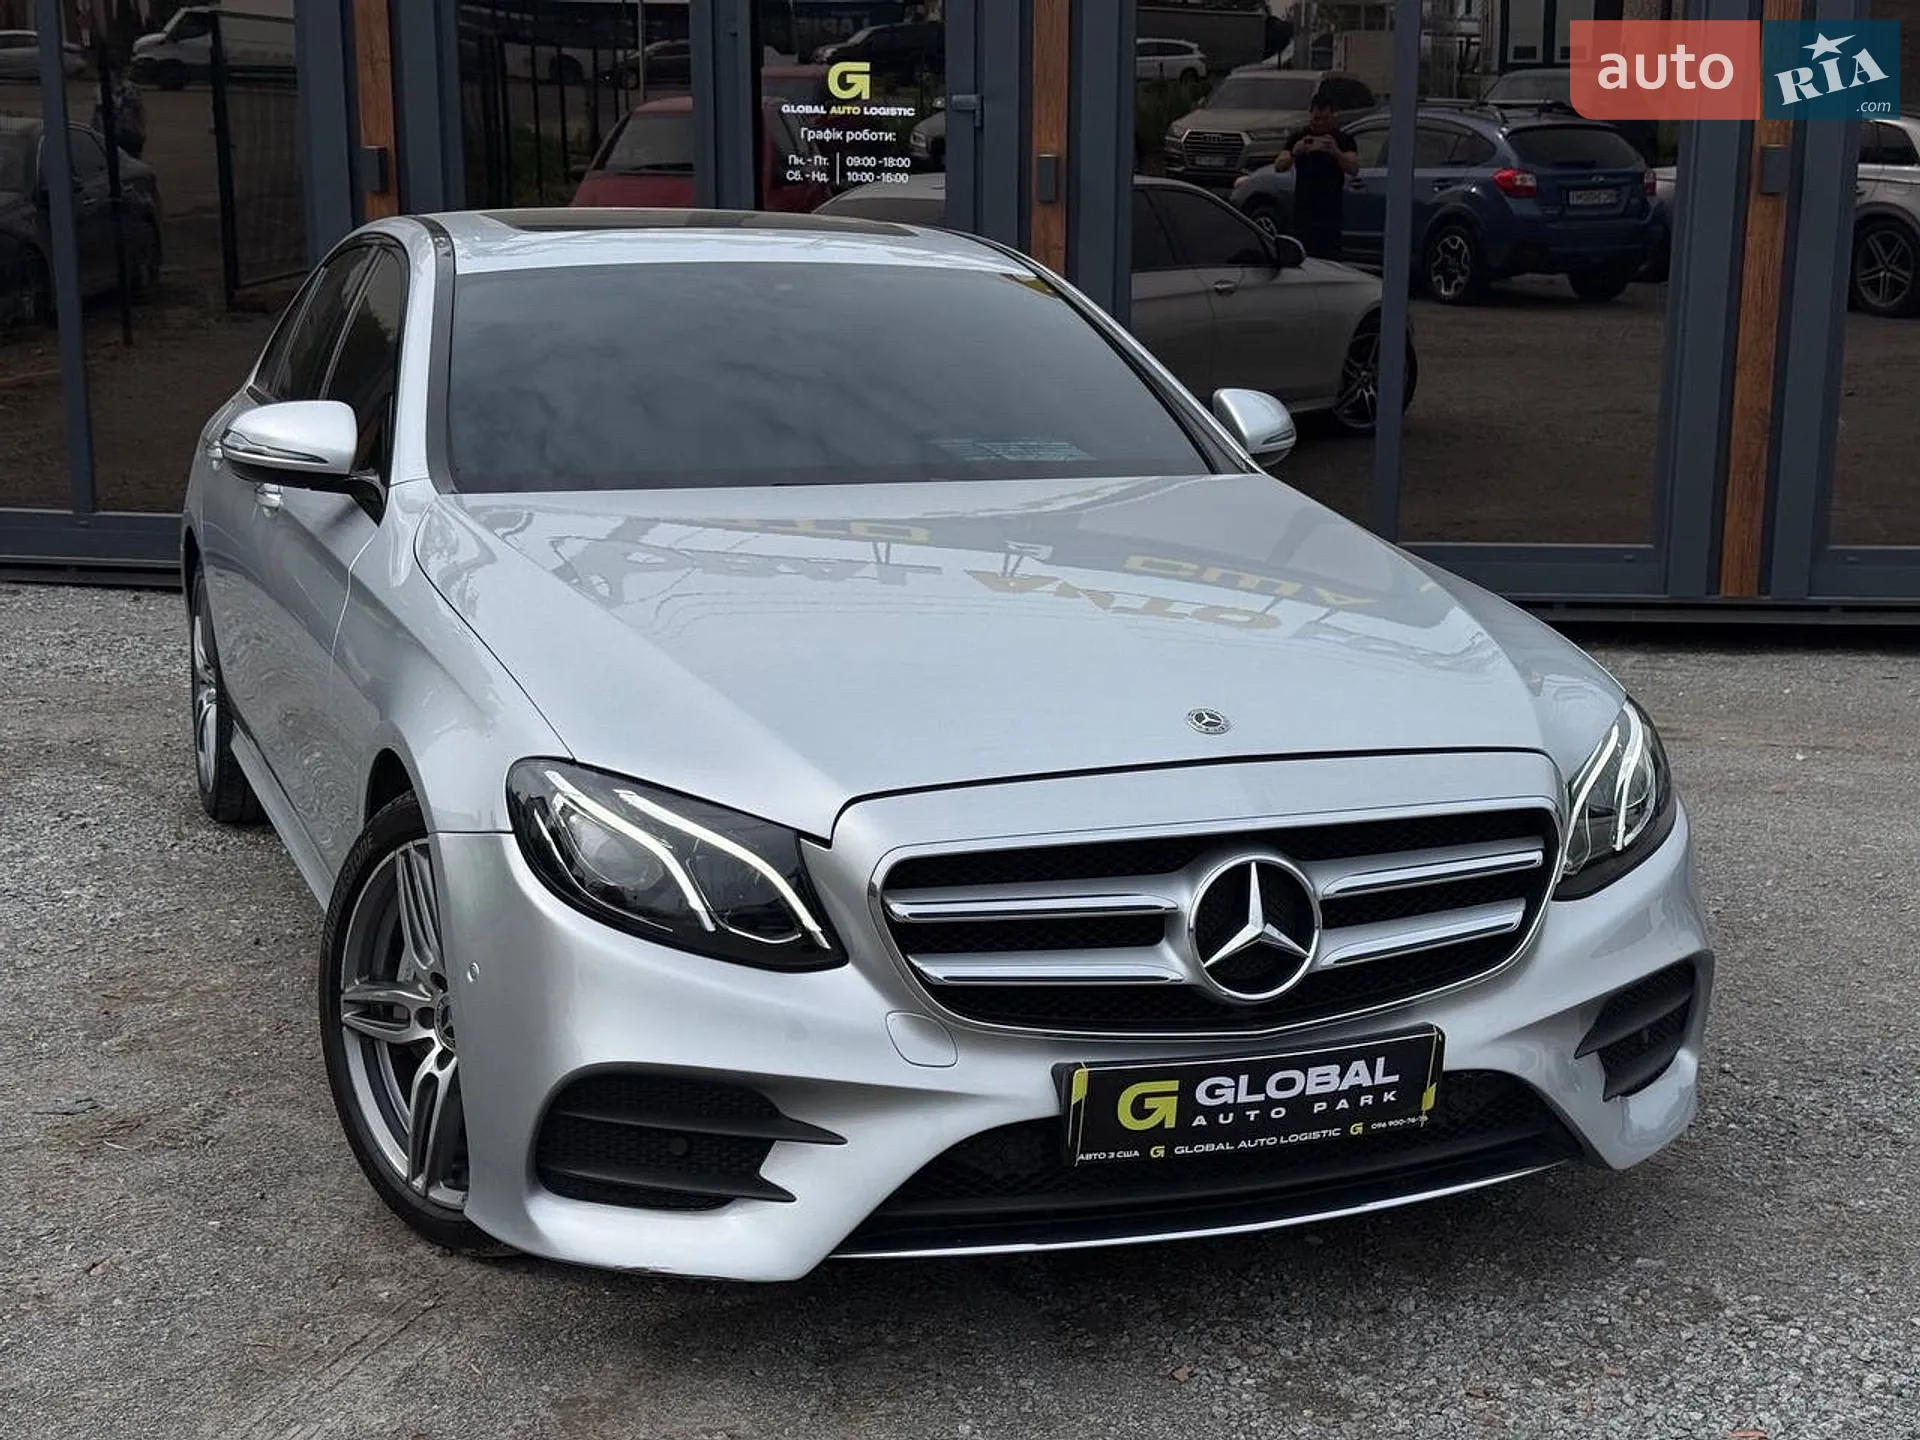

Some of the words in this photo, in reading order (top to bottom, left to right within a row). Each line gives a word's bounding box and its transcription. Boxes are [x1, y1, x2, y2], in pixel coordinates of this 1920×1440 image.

[781, 103, 827, 114] GLOBAL
[829, 105, 861, 115] AUTO
[863, 106, 916, 116] LOGISTIC
[800, 127, 843, 142] Графік
[845, 129, 897, 143] роботи:
[1195, 1056, 1400, 1107] GLOBAL
[1191, 1106, 1287, 1127] AUTO
[1313, 1090, 1398, 1114] PARK
[1174, 1141, 1235, 1154] GLOBAL
[1237, 1136, 1278, 1149] AUTO
[1279, 1128, 1342, 1144] LOGISTIC
[1079, 1151, 1107, 1161] АВТО
[1116, 1150, 1140, 1158] США
